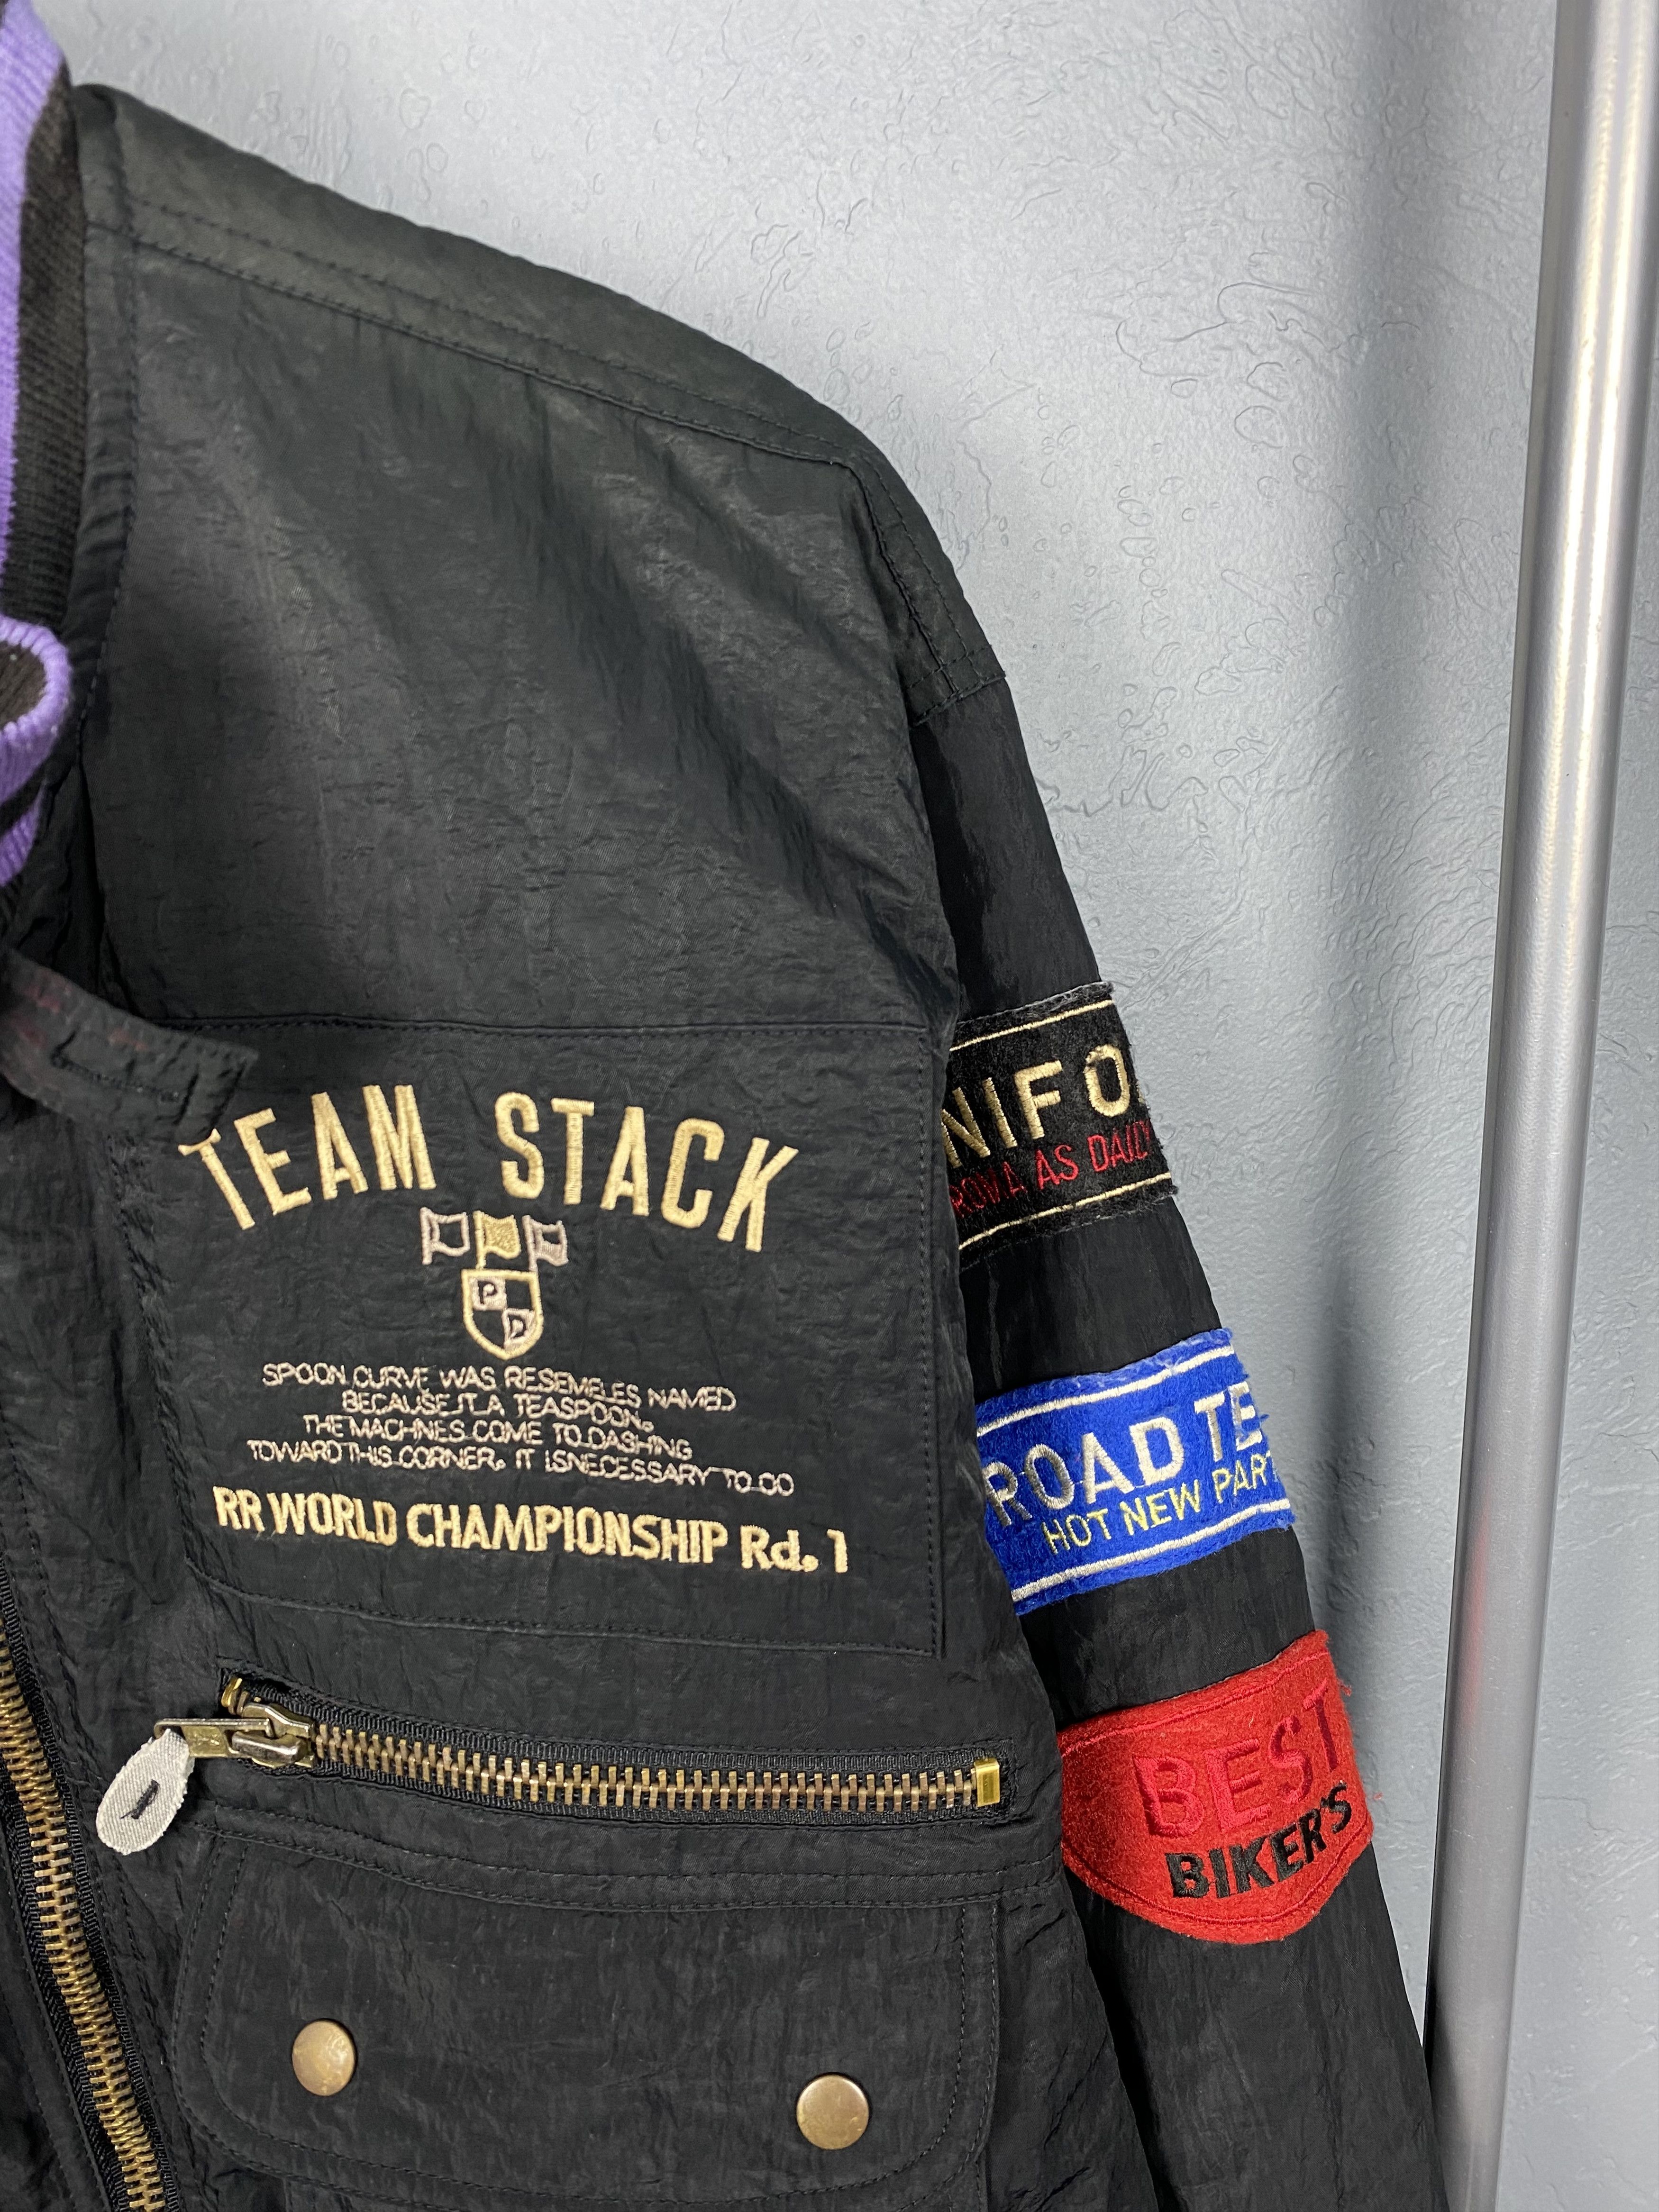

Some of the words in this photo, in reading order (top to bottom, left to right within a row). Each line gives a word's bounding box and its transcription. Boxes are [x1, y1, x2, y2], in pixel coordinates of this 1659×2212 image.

[940, 1044, 1146, 1168] NIFO
[178, 1085, 436, 1229] TEAM
[495, 1092, 798, 1252] STACK
[1035, 1145, 1079, 1189] AS
[262, 1362, 346, 1386] SPOON
[353, 1365, 429, 1389] CURVE
[439, 1365, 497, 1392] WAS
[648, 1387, 737, 1411] NAMED
[342, 1389, 451, 1418] BECAUSE
[247, 1439, 342, 1464] TOWARD
[348, 1442, 393, 1468] THIS
[515, 1448, 535, 1469] IT
[723, 1468, 752, 1493] TO
[303, 1414, 345, 1438] THE
[473, 1420, 543, 1446] COME
[552, 1422, 582, 1447] TO
[588, 1426, 693, 1461] DASHING
[982, 1416, 1184, 1527] ROAD
[213, 1486, 265, 1532] RR
[266, 1492, 398, 1547] WORLD
[406, 1502, 729, 1564] CHAMPIONSHIP
[740, 1525, 819, 1572] Rd.
[826, 1528, 848, 1574] 1
[1041, 1508, 1112, 1555] HOT
[1119, 1479, 1201, 1536] NEW
[1132, 1678, 1338, 1839] BEST
